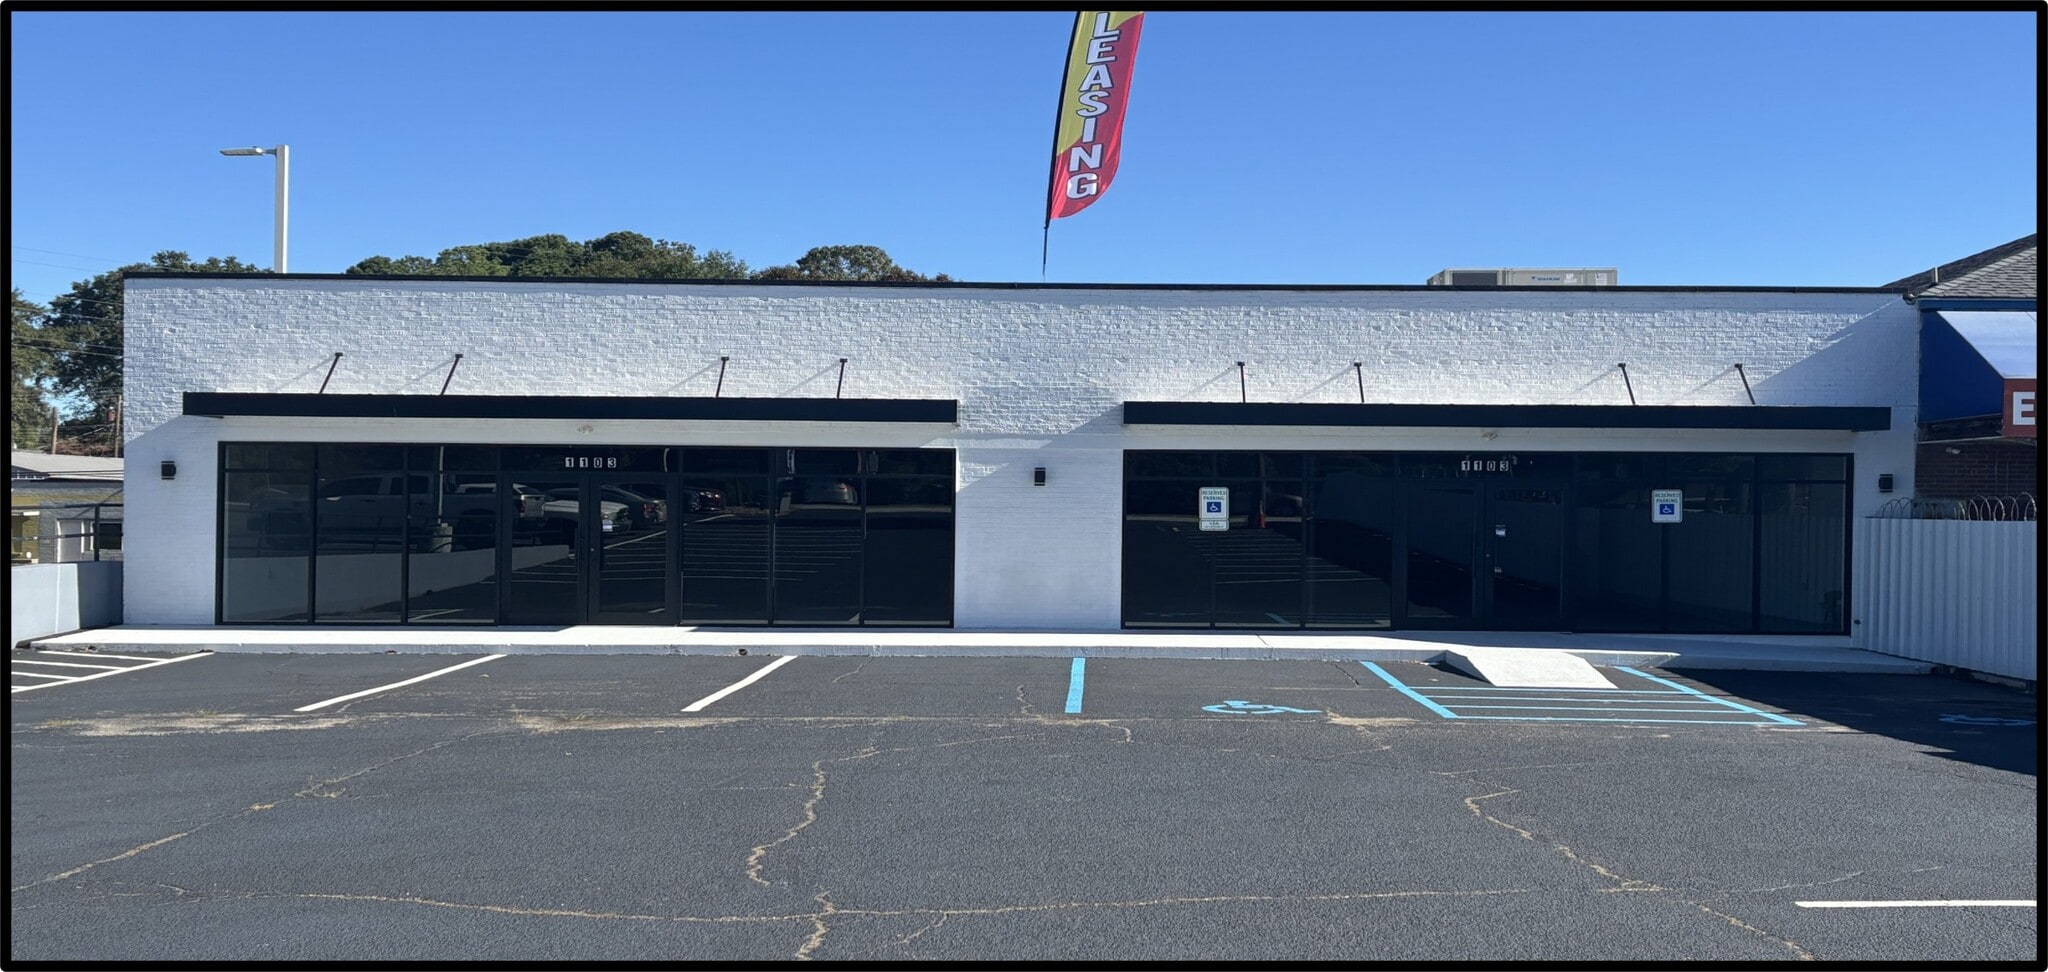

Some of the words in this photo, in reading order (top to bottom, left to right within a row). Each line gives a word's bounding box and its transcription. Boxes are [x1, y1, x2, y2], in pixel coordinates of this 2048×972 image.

[1066, 12, 1120, 199] LEASING
[2012, 391, 2036, 425] E
[565, 457, 617, 469] 1103
[1461, 460, 1509, 471] 1103
